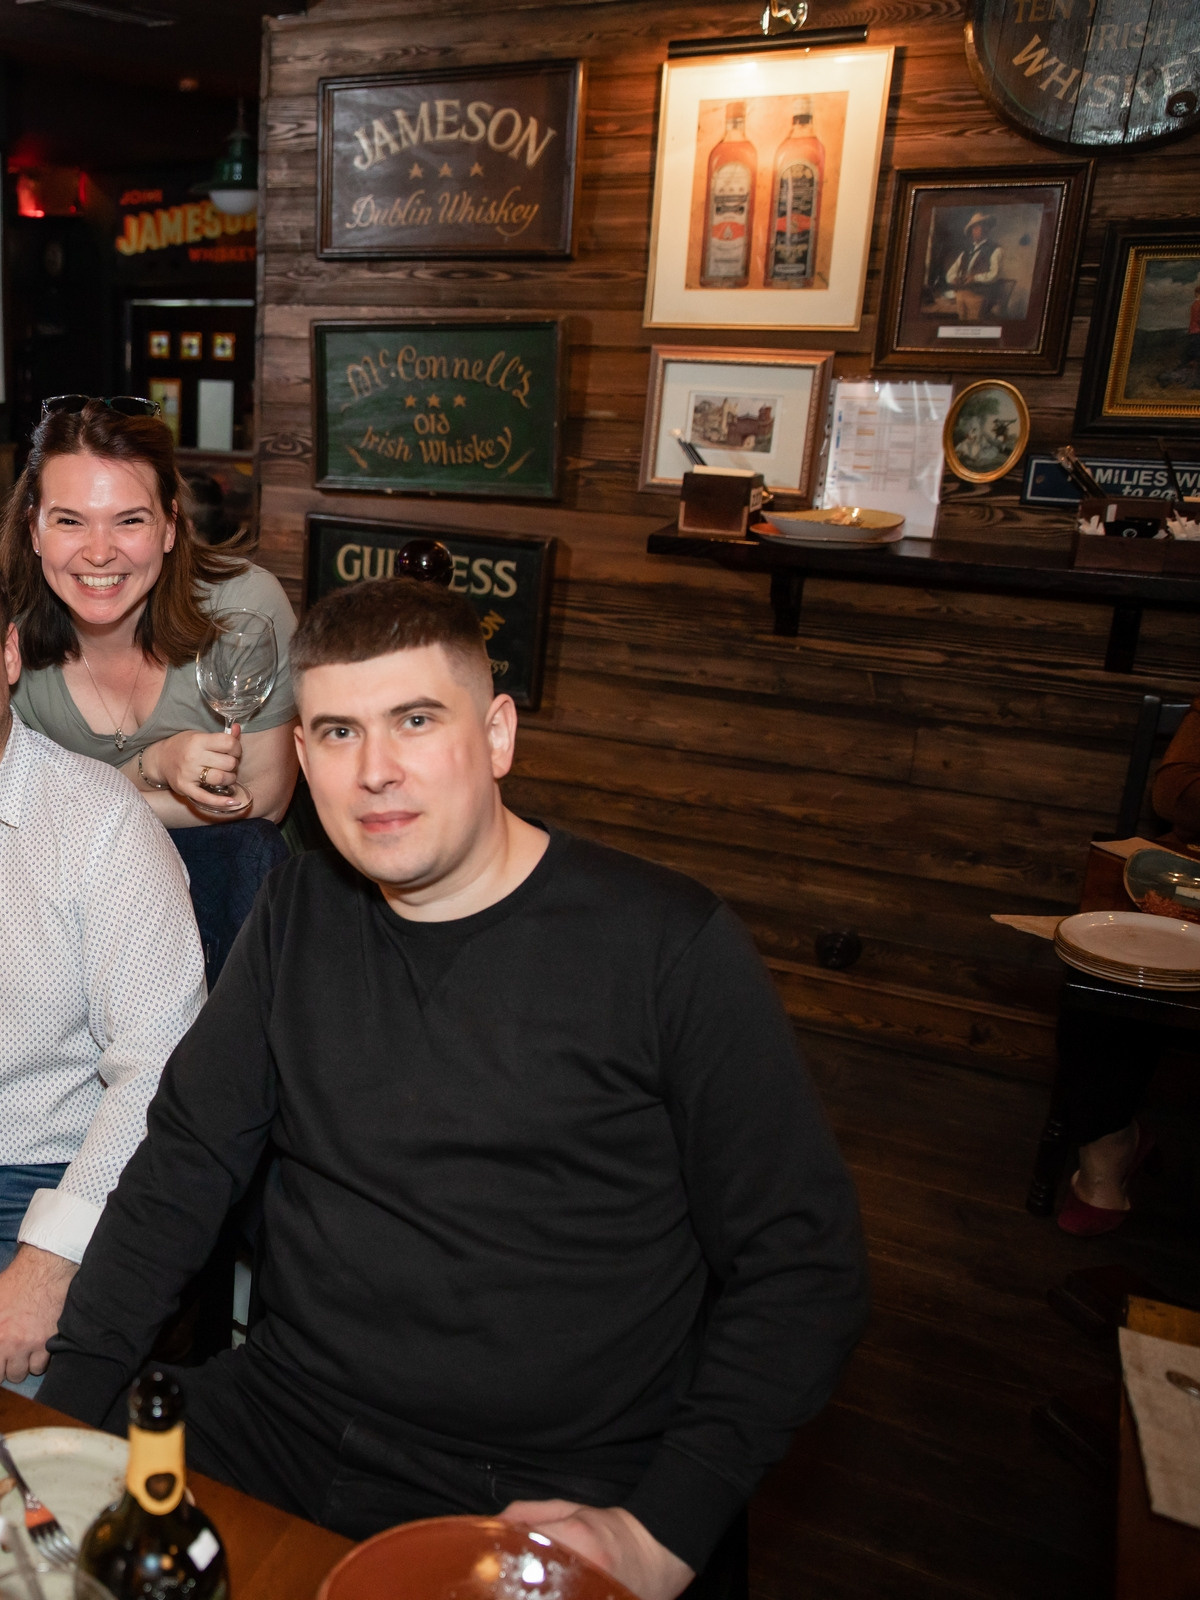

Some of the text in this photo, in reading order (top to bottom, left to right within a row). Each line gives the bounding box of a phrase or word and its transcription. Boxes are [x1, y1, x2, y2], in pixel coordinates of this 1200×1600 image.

[1011, 33, 1200, 109] WHISKE
[353, 99, 557, 169] JAMESON
[345, 186, 540, 237] Dublin Whiskey
[360, 425, 513, 469] Irish Whiskey
[413, 412, 451, 435] Old
[336, 543, 519, 599] GUIESS
